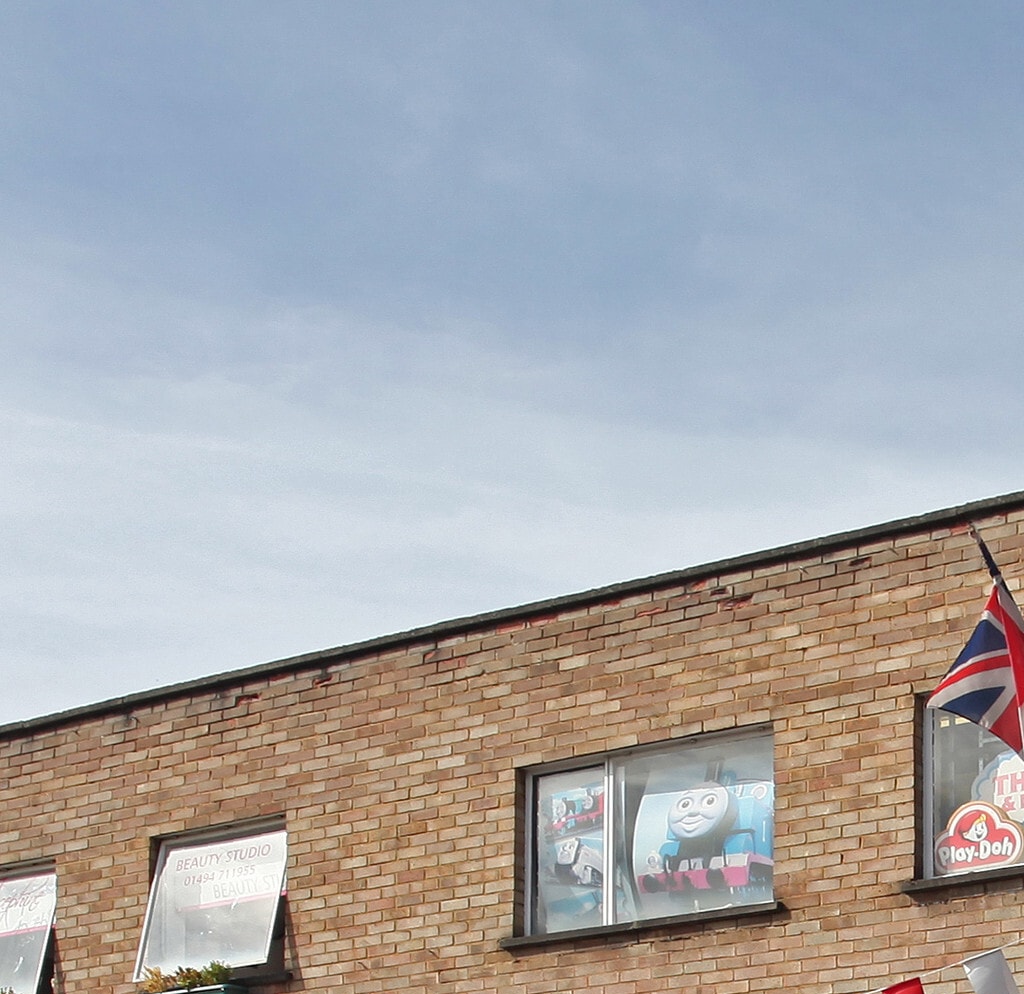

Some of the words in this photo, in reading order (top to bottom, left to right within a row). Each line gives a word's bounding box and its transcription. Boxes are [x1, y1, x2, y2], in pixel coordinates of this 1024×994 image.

[1002, 796, 1016, 812] &
[175, 854, 222, 872] BEAUTY
[225, 843, 271, 863] STUDIO
[938, 836, 1013, 867] Play-Doh
[184, 873, 216, 887] 01494
[219, 865, 256, 881] 711955
[213, 877, 259, 899] BEAUTY
